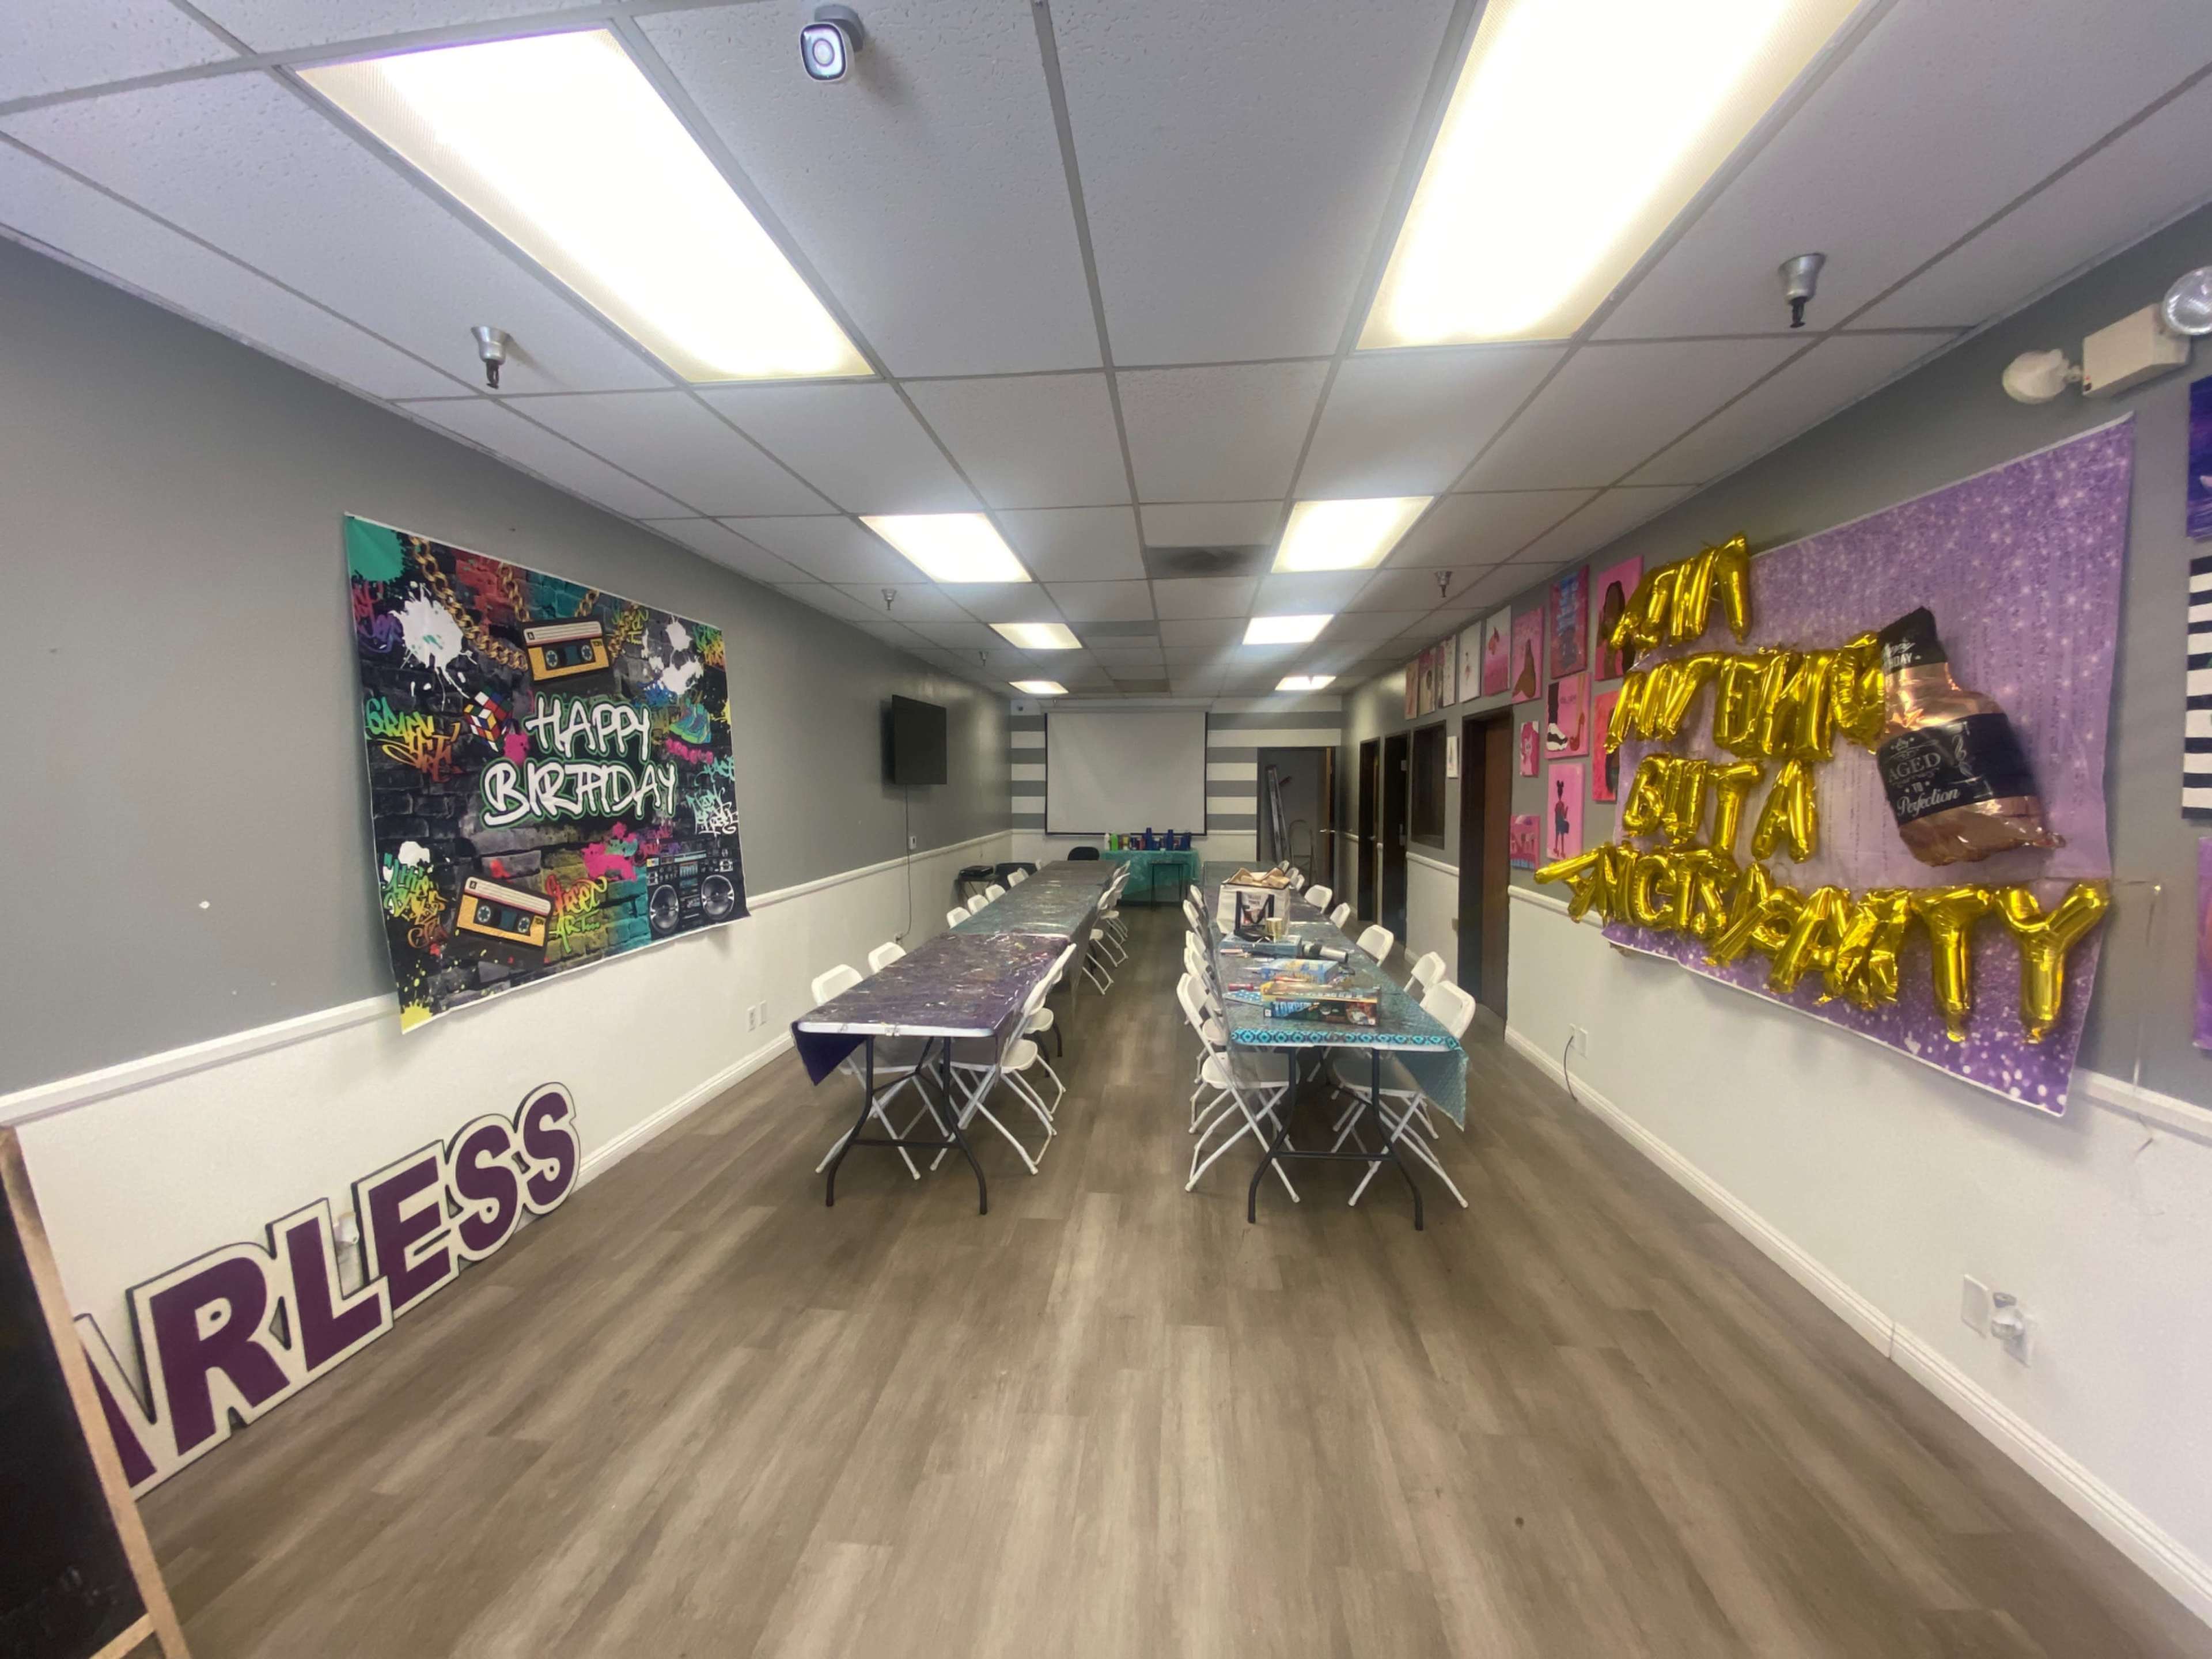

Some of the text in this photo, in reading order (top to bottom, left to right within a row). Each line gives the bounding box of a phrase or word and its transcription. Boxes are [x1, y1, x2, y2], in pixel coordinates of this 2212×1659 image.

[525, 695, 650, 763] HAPPY
[1889, 752, 1941, 782] AGED
[483, 761, 676, 826] BIRTHDAY
[1896, 788, 1960, 817] Perfection
